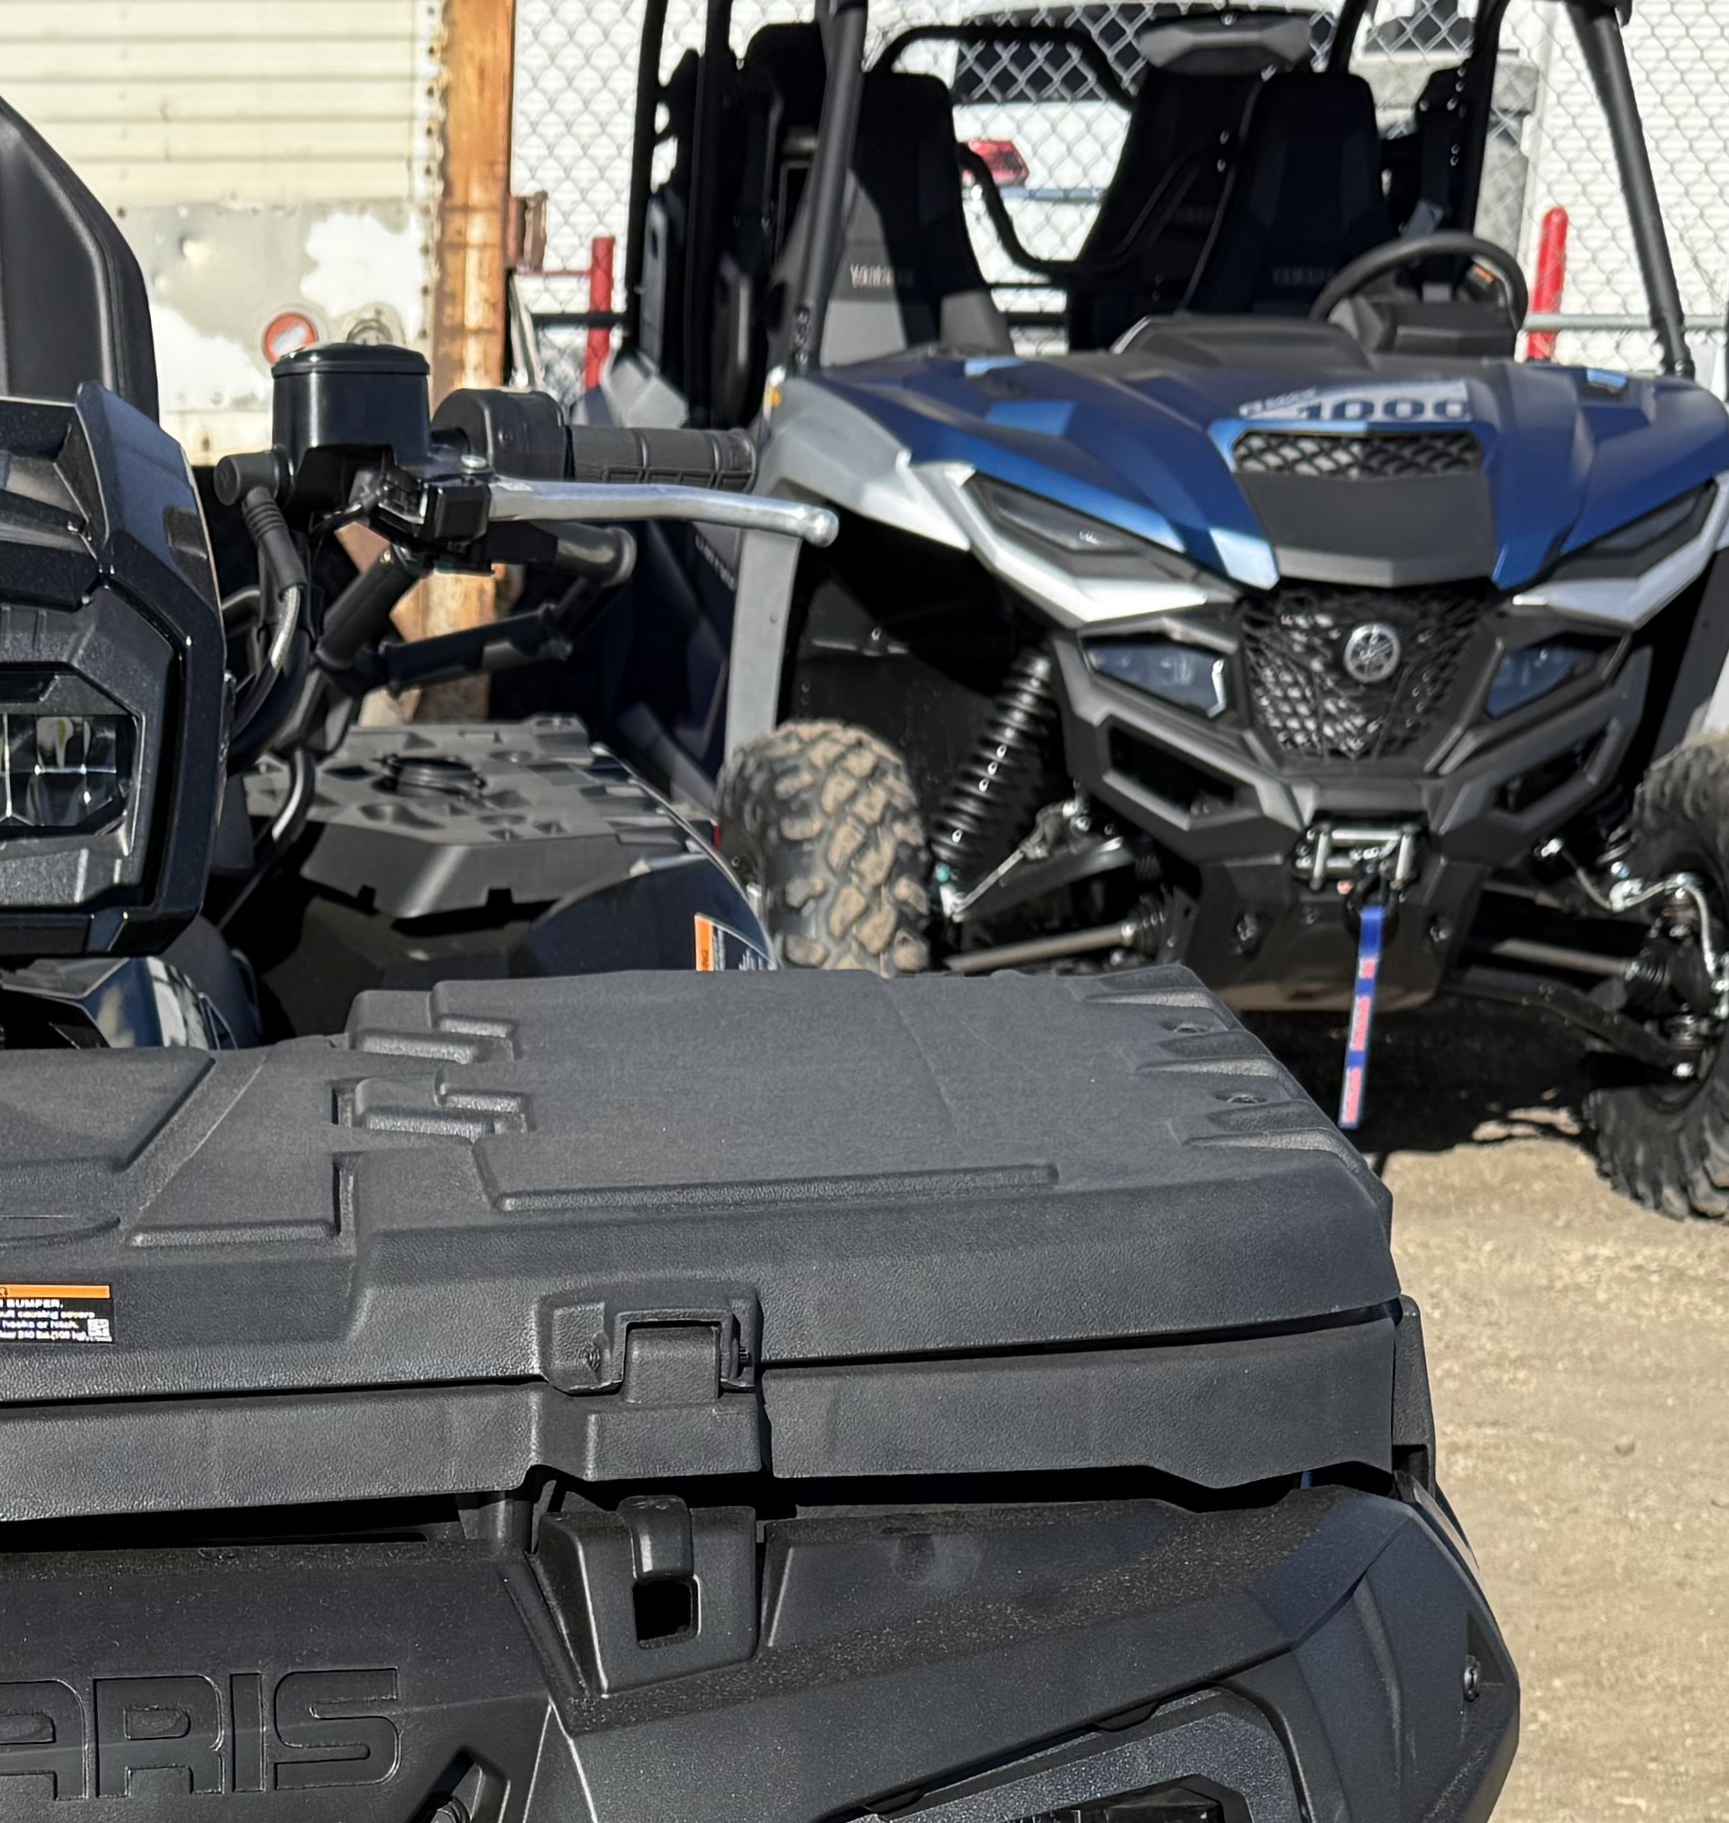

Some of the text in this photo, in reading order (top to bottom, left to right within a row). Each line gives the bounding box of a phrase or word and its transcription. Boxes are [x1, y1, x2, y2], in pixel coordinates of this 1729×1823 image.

[1297, 398, 1469, 421] 1000
[6, 1299, 64, 1309] BUMPER.
[17, 1309, 59, 1320] causing
[60, 1311, 96, 1319] severe
[36, 1321, 49, 1329] or
